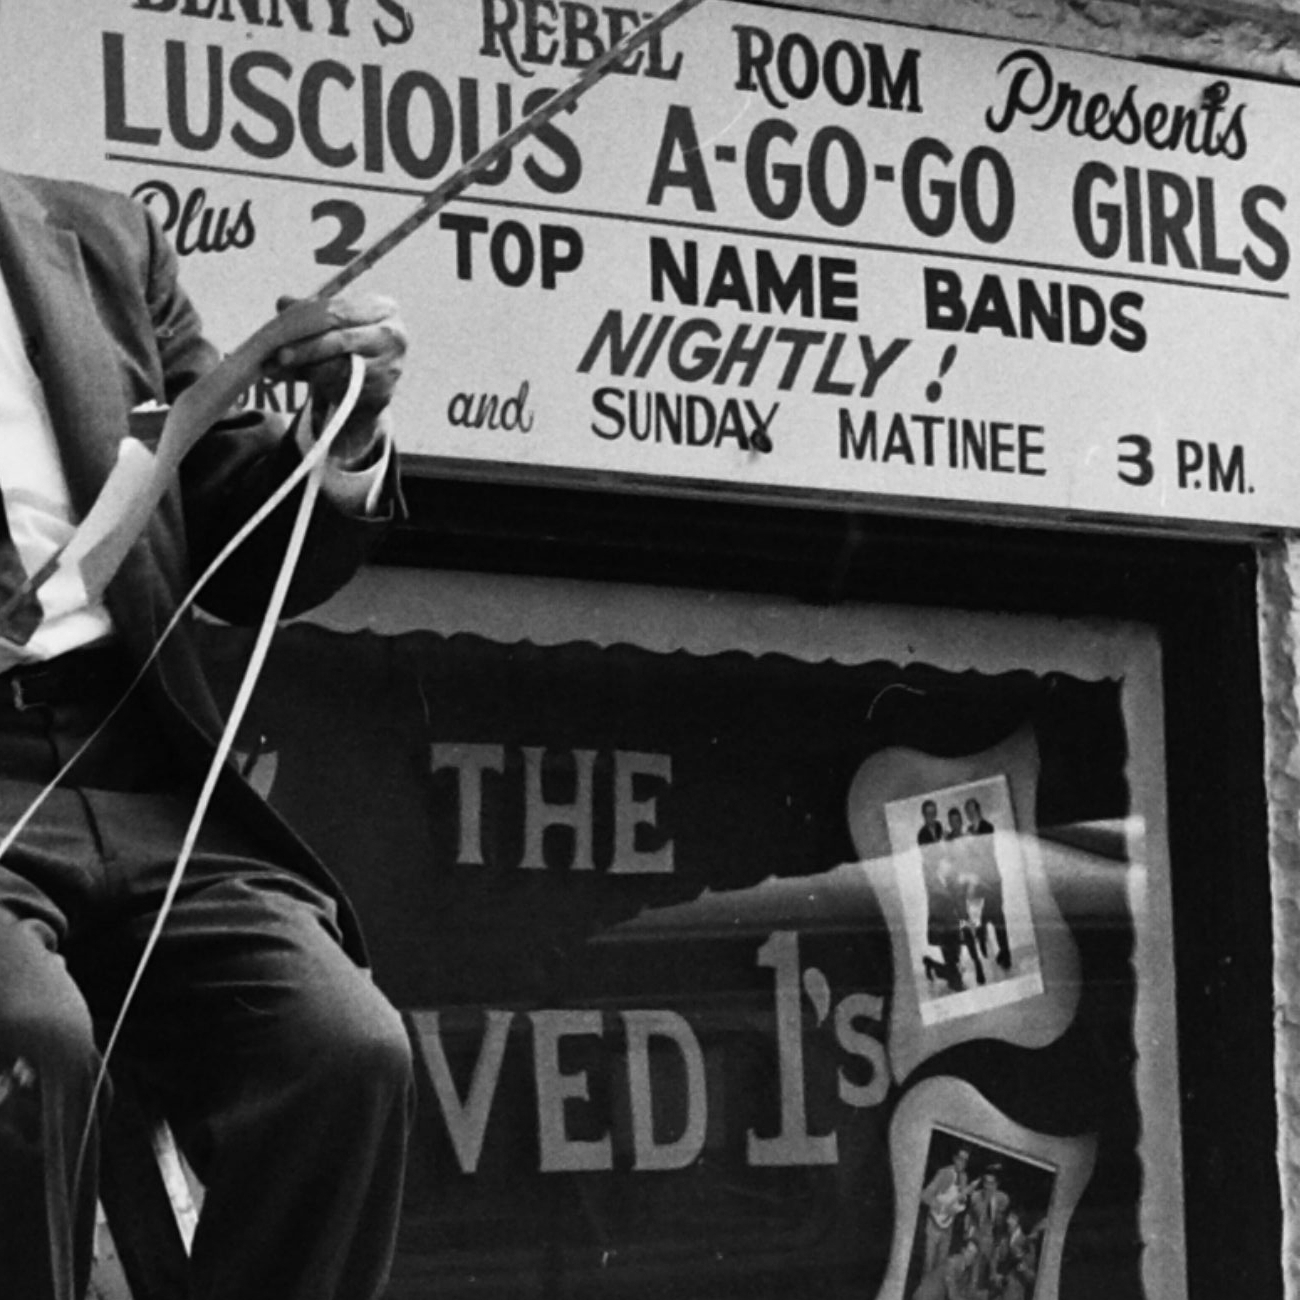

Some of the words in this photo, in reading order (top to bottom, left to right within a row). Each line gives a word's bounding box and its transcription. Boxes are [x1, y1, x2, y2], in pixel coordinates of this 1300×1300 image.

[101, 31, 583, 195] LUSCIOUS
[646, 104, 1016, 244] A-GO-GO
[1071, 160, 1290, 282] GIRLS
[731, 24, 922, 113] ROOM
[985, 48, 1248, 161] Presents
[131, 179, 256, 257] Plus
[311, 198, 367, 267] 2
[439, 212, 585, 291] TOP
[649, 236, 859, 322] NAME
[923, 266, 1148, 353] BANDS
[447, 380, 535, 434] and
[590, 386, 780, 452] SUNDAY
[838, 407, 1048, 477] MATINEE
[1116, 433, 1155, 487] 3
[1177, 438, 1256, 494] P.M.
[430, 741, 675, 876] THE
[409, 1007, 708, 1173] VED
